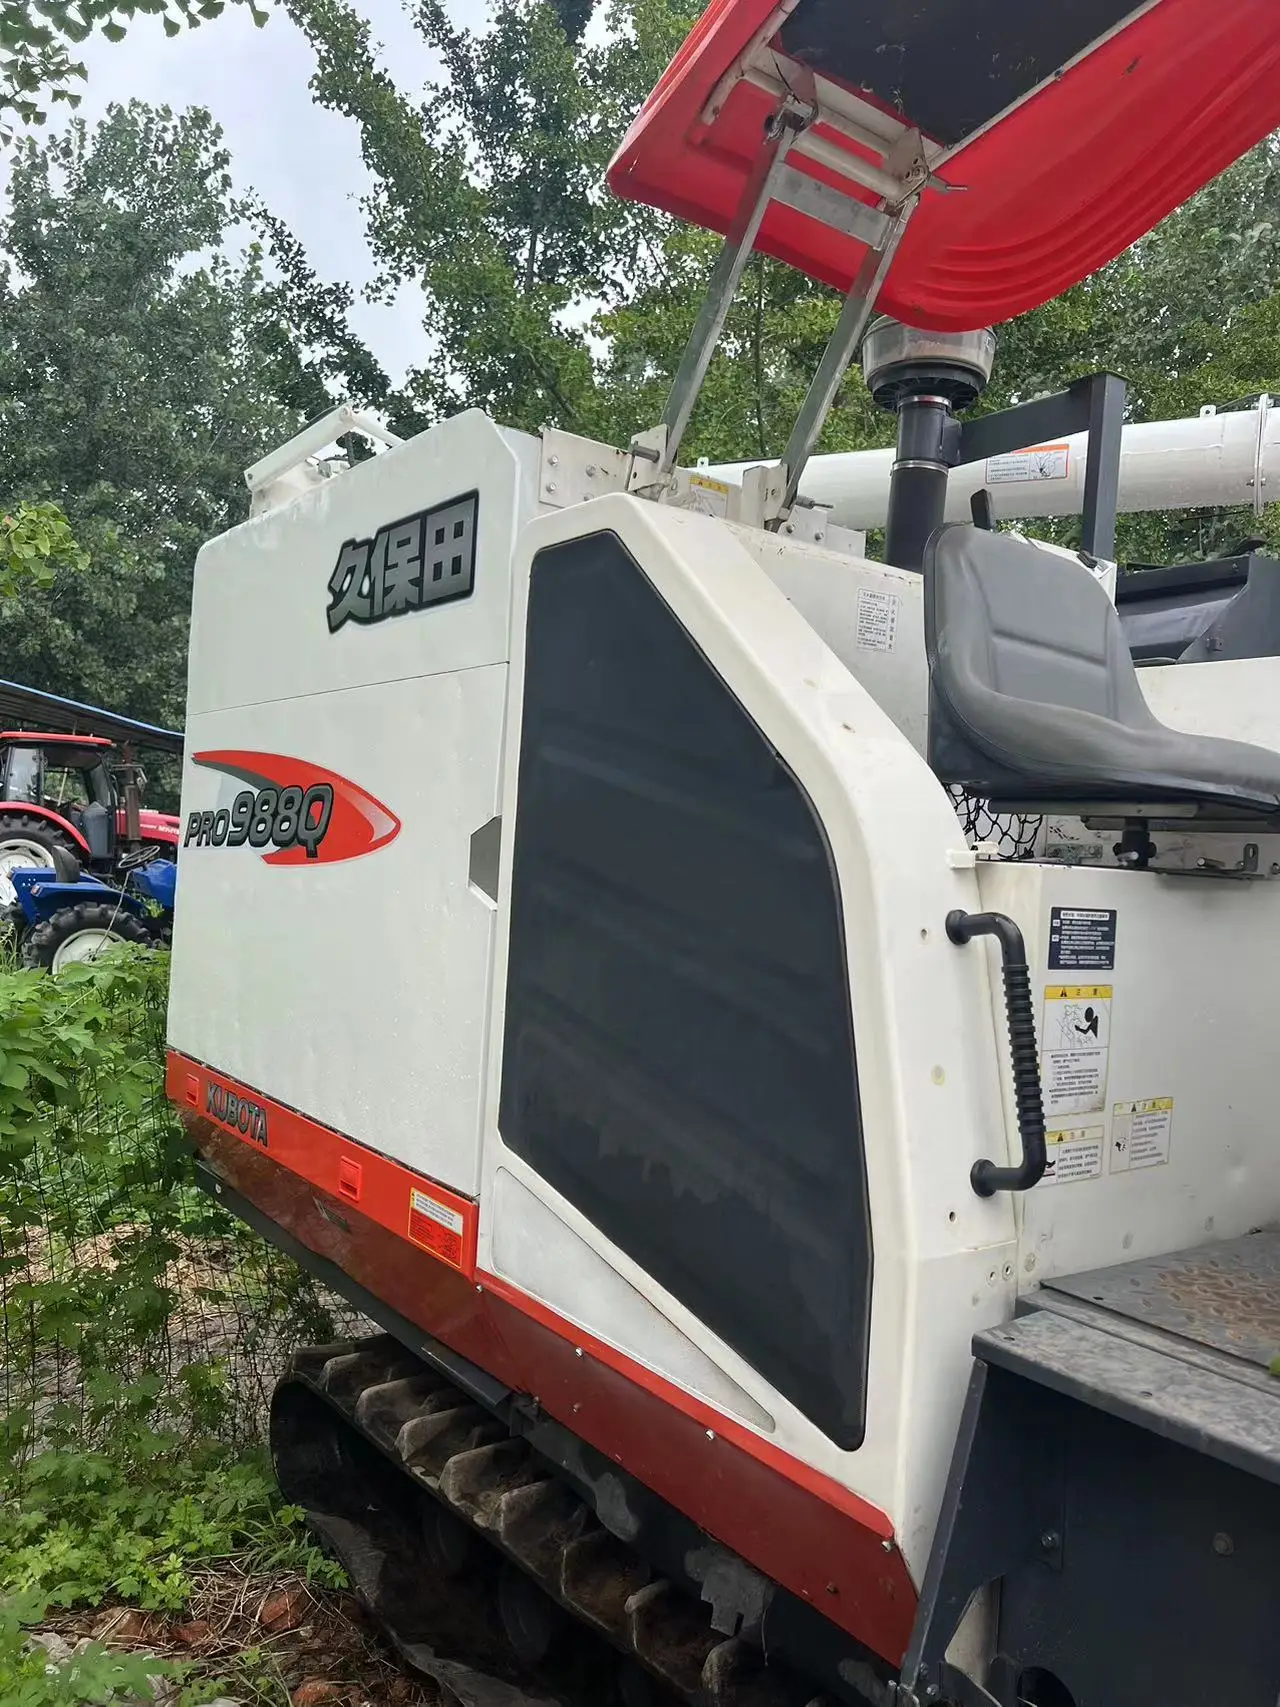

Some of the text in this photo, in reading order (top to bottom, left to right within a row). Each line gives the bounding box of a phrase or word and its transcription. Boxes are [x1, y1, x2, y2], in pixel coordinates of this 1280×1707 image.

[327, 488, 479, 634] 久保田
[207, 1081, 268, 1147] KUBOTA
